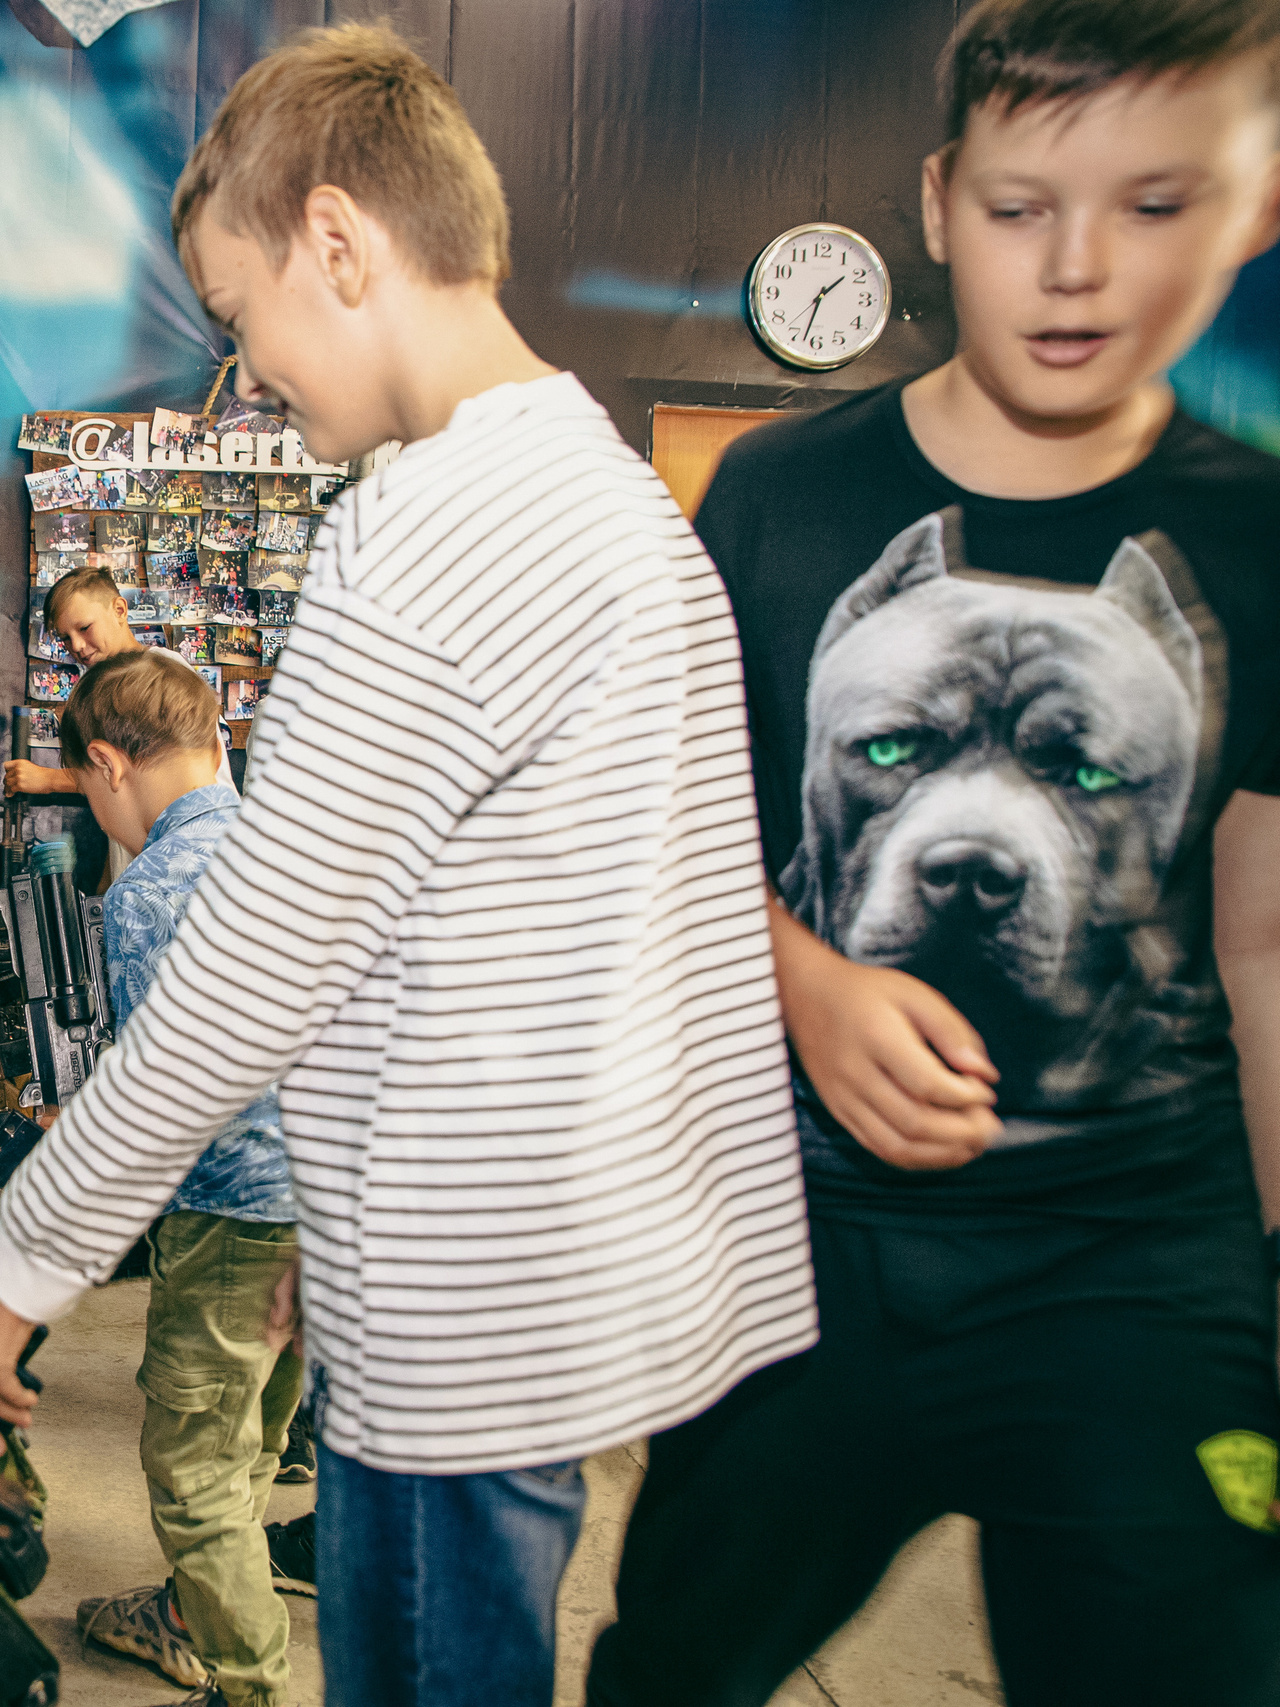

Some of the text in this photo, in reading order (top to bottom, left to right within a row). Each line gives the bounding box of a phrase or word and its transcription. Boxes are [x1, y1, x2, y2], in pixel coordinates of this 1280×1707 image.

[792, 248, 807, 262] 11
[813, 242, 832, 258] 12
[841, 251, 846, 265] 1
[775, 264, 792, 279] 10
[853, 268, 866, 283] 2
[767, 286, 780, 300] 9
[859, 291, 872, 307] 3
[772, 310, 785, 325] 8
[850, 315, 862, 329] 4
[788, 327, 801, 341] 7
[832, 331, 845, 345] 5
[810, 335, 823, 350] 6
